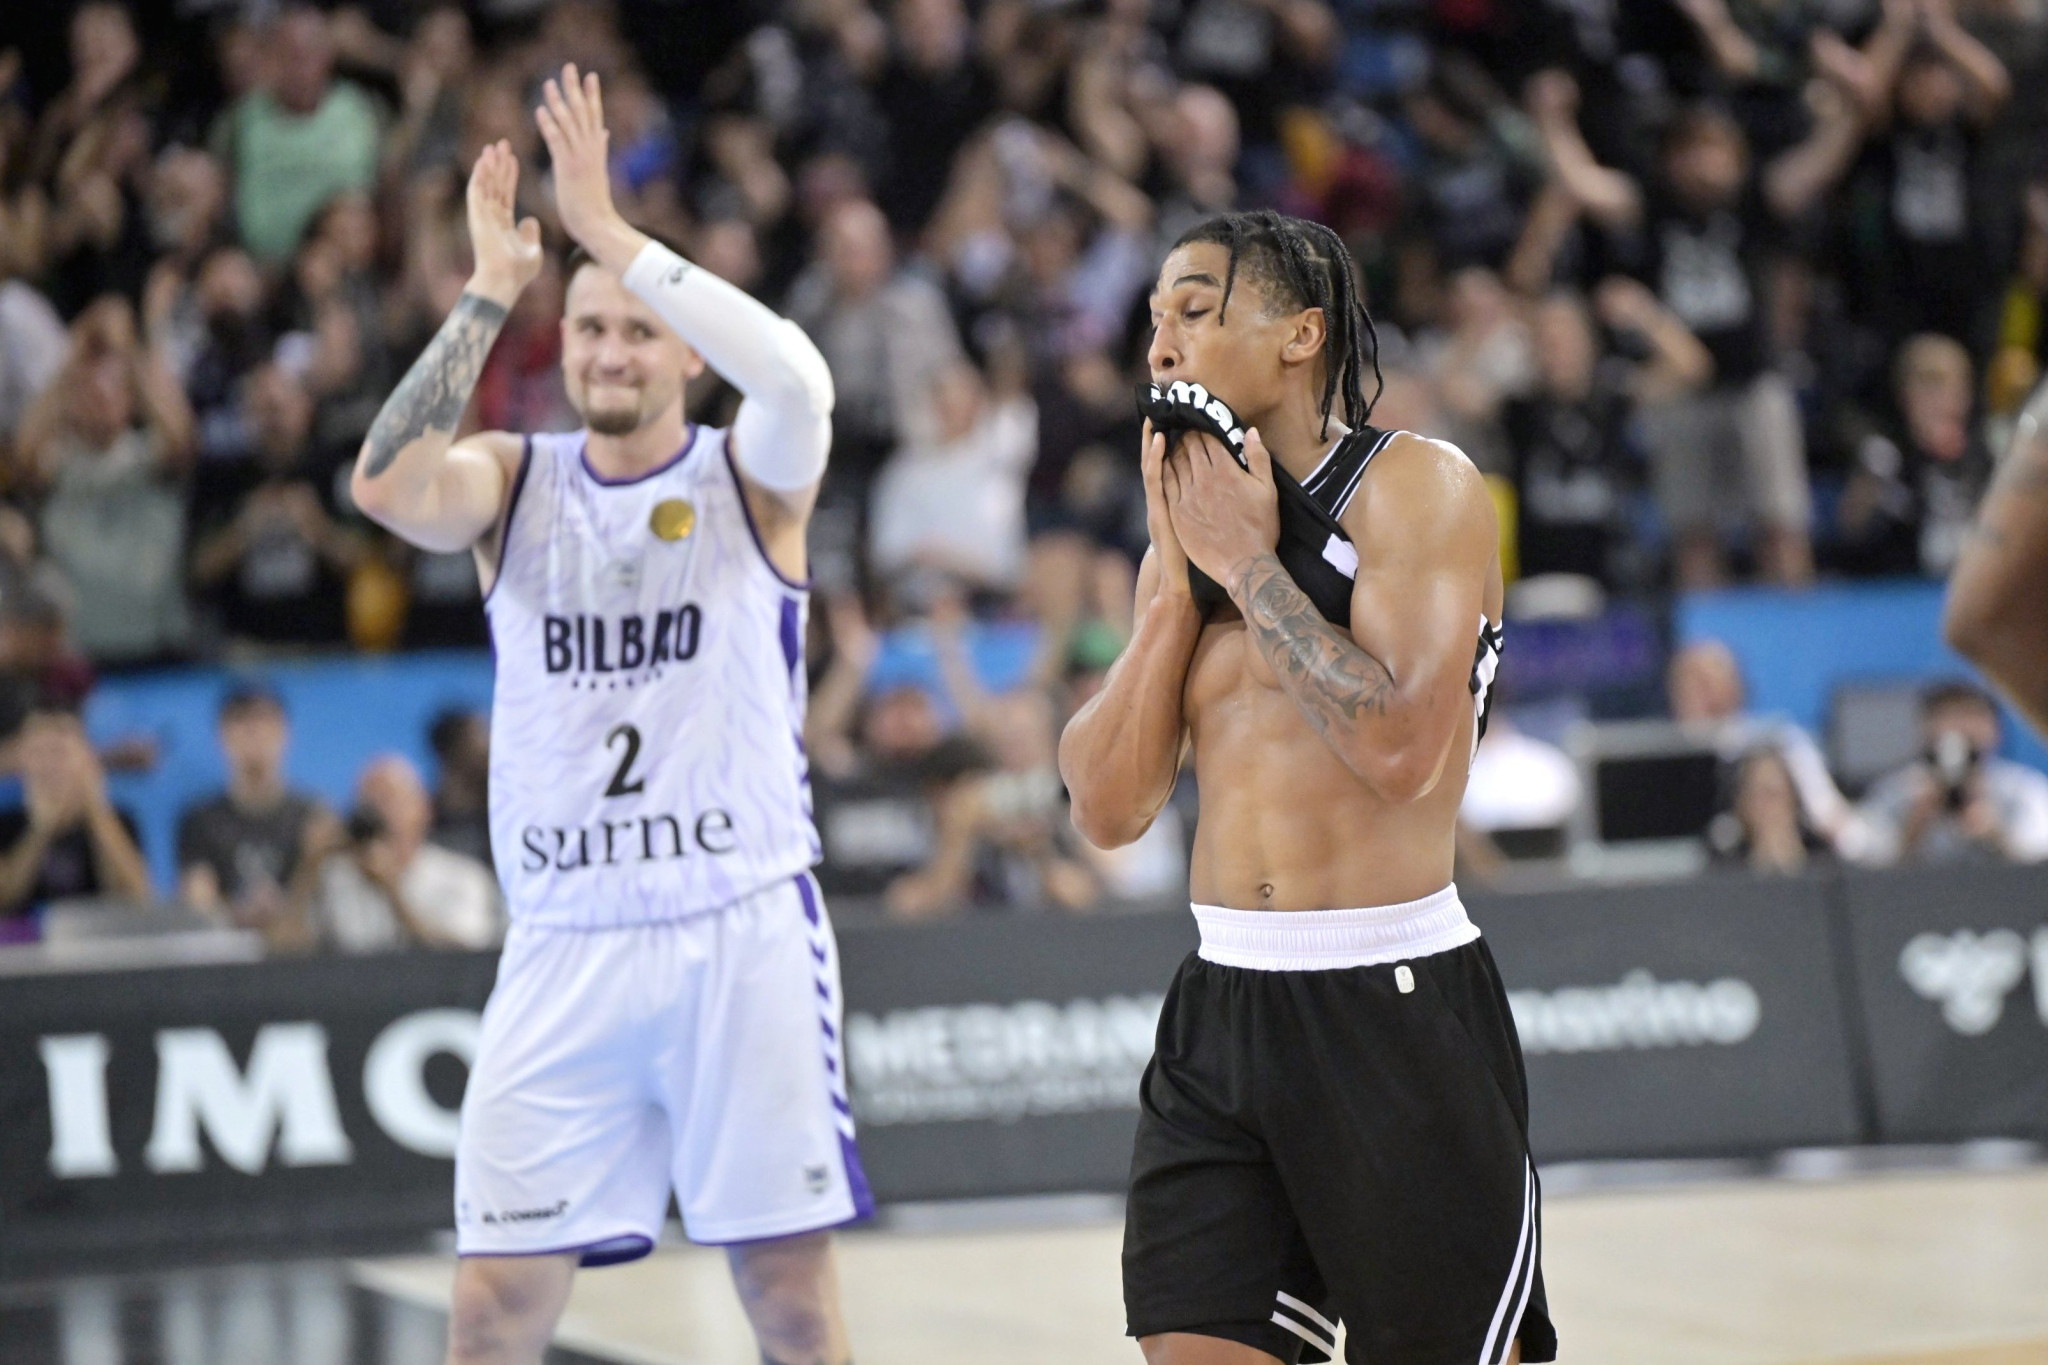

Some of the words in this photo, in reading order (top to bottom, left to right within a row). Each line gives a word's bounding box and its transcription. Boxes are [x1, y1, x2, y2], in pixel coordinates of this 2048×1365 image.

[543, 602, 703, 675] BILBAO
[602, 722, 645, 798] 2
[521, 808, 735, 874] surne
